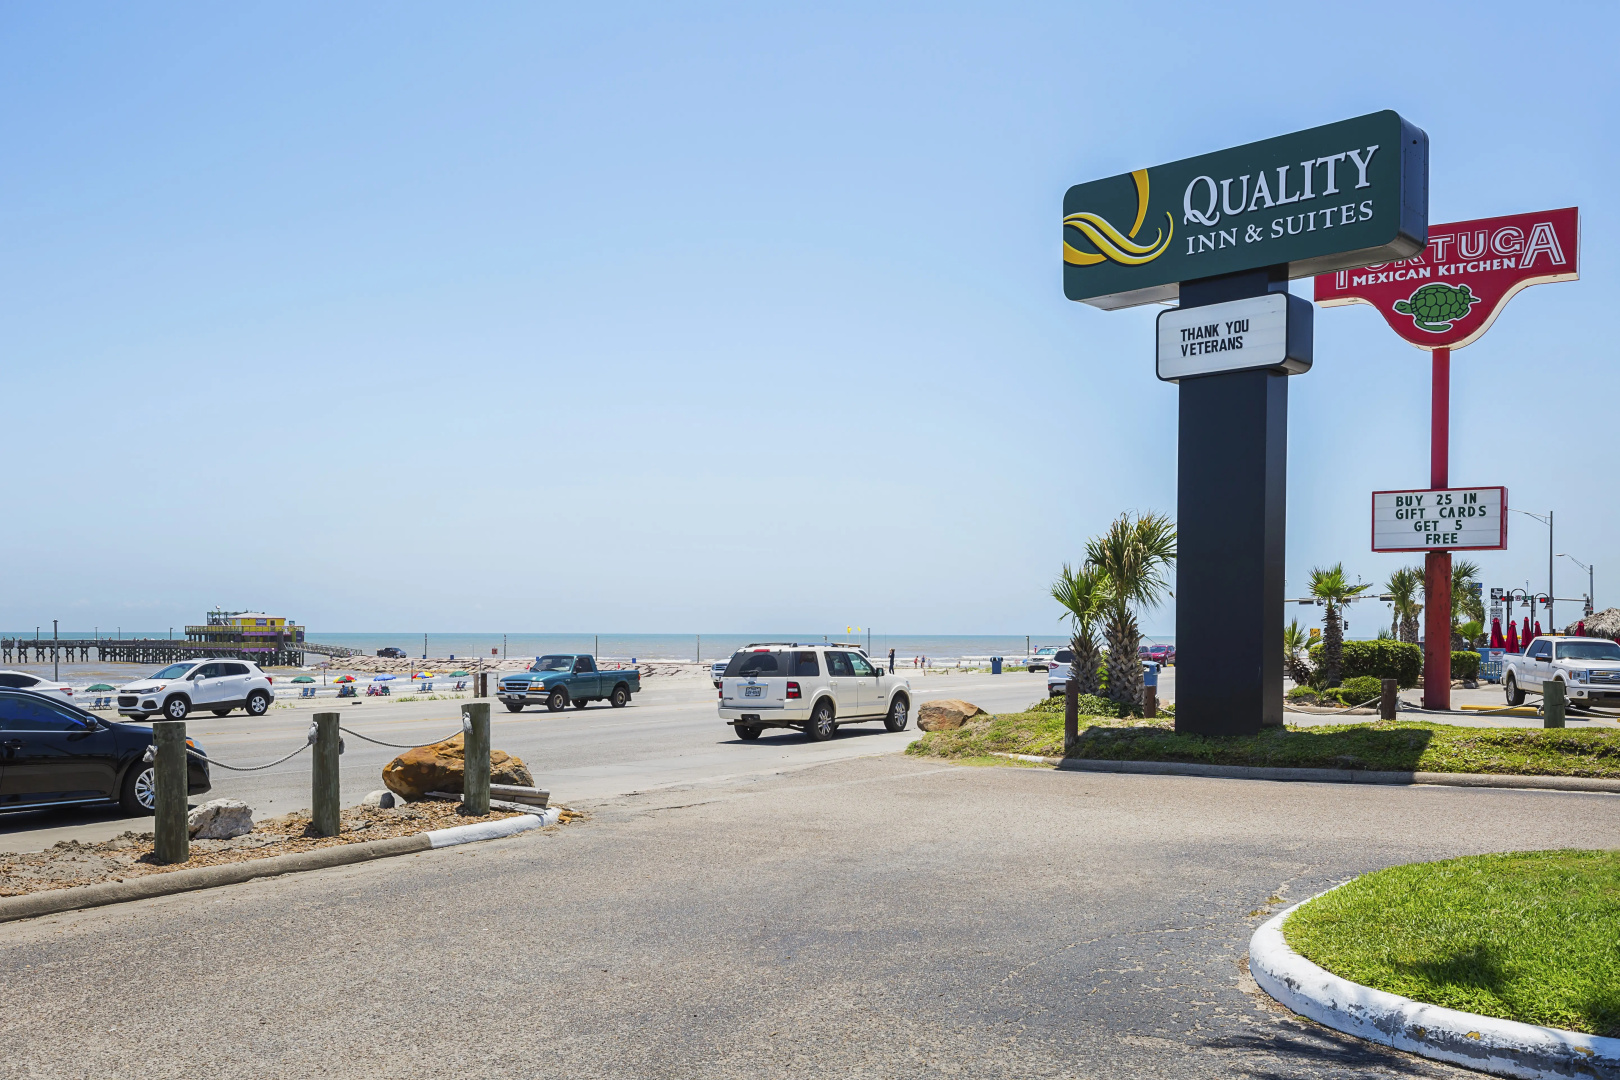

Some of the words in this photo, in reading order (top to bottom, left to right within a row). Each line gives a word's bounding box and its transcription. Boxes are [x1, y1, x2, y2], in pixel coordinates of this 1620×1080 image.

[1183, 145, 1380, 227] QUALITY
[1186, 227, 1238, 255] INN
[1245, 224, 1263, 244] &
[1270, 200, 1374, 239] SUITES
[1335, 222, 1566, 290] TUGA
[1352, 267, 1431, 287] MEXICAN
[1438, 257, 1516, 277] KITCHEN
[1180, 323, 1219, 342] THANK
[1225, 318, 1250, 335] YOU
[1181, 335, 1244, 357] VETERANS
[1396, 495, 1423, 507] BUY
[1436, 494, 1452, 505] 25
[1464, 492, 1477, 504] IN
[1395, 508, 1426, 520] GIFT
[1439, 505, 1487, 518] CARDS
[1414, 520, 1439, 532] GET
[1455, 520, 1463, 530] 5
[1425, 533, 1458, 544] FREE
